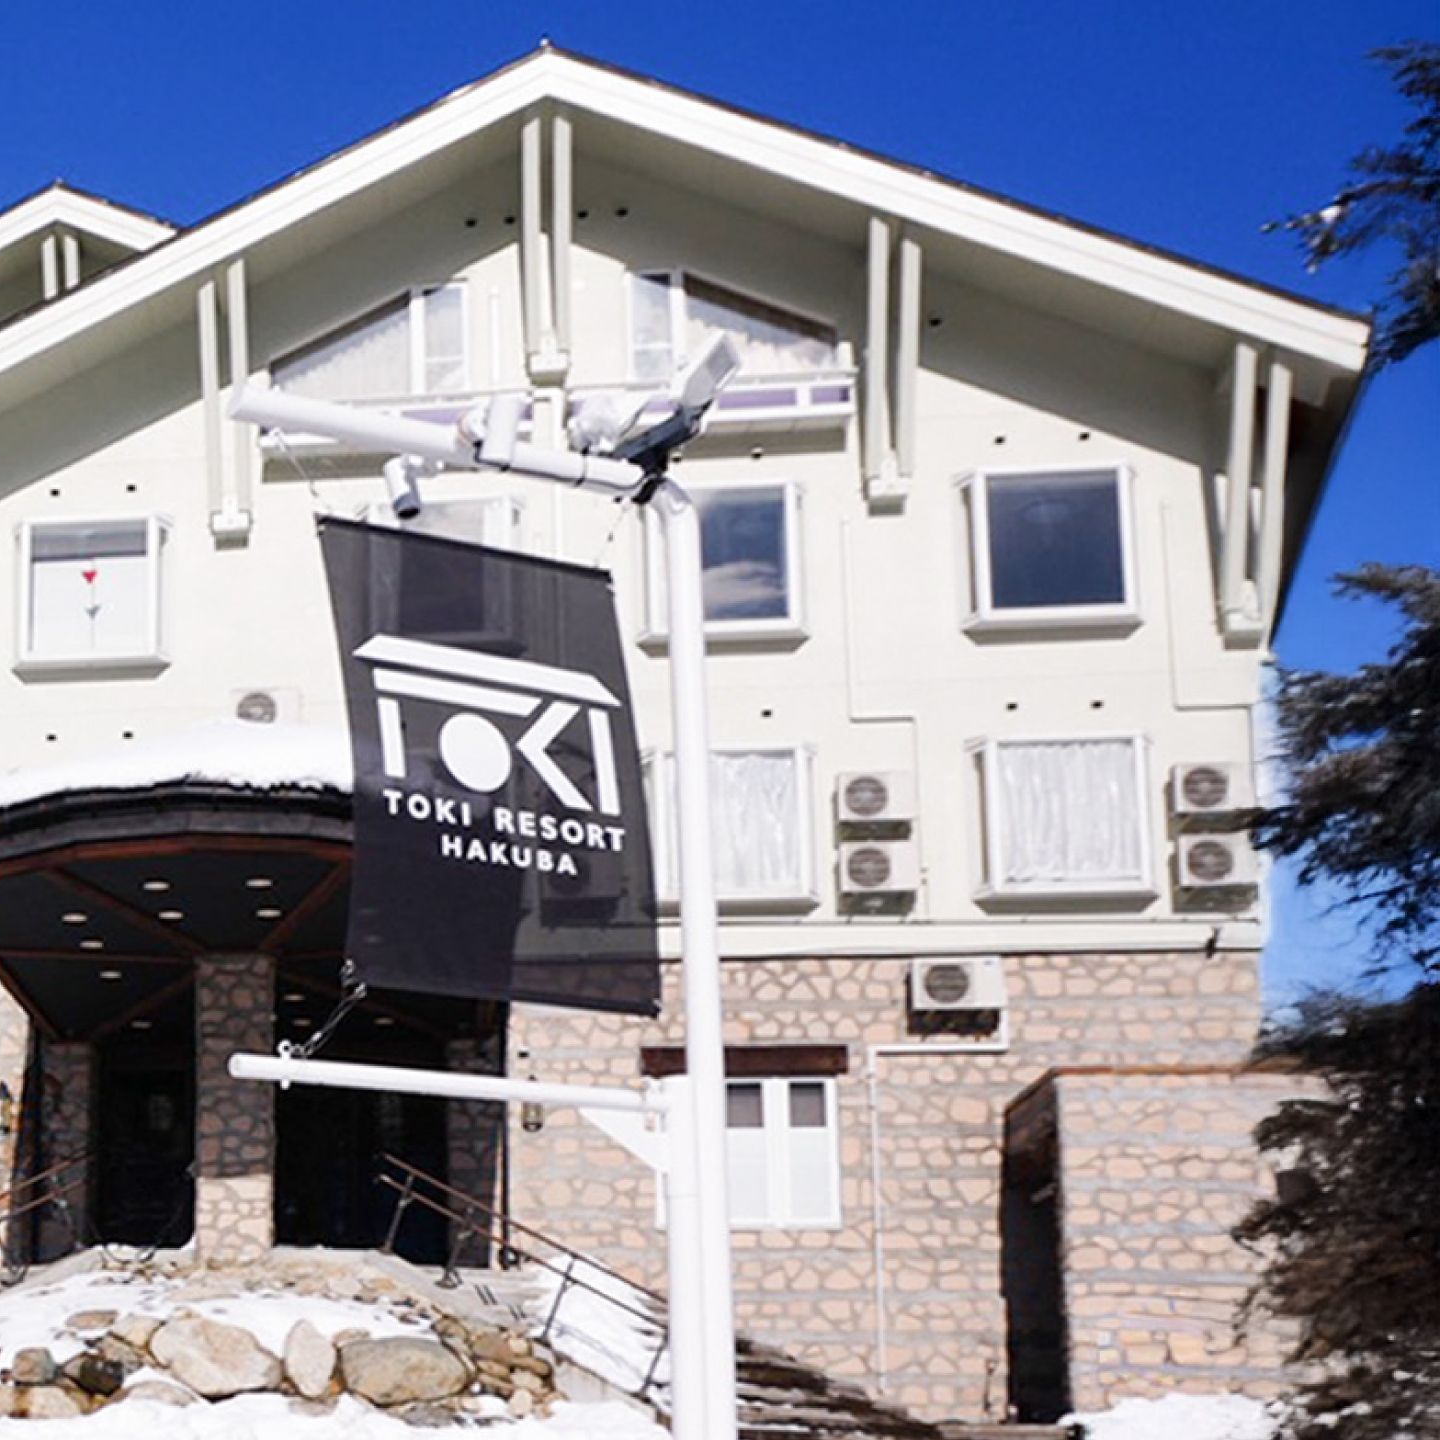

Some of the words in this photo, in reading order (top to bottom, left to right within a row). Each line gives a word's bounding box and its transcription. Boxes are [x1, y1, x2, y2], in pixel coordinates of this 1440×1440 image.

[373, 667, 621, 817] TOKI
[382, 788, 472, 827] TOKI
[494, 806, 626, 852] RESORT
[441, 834, 578, 877] HAKUBA
